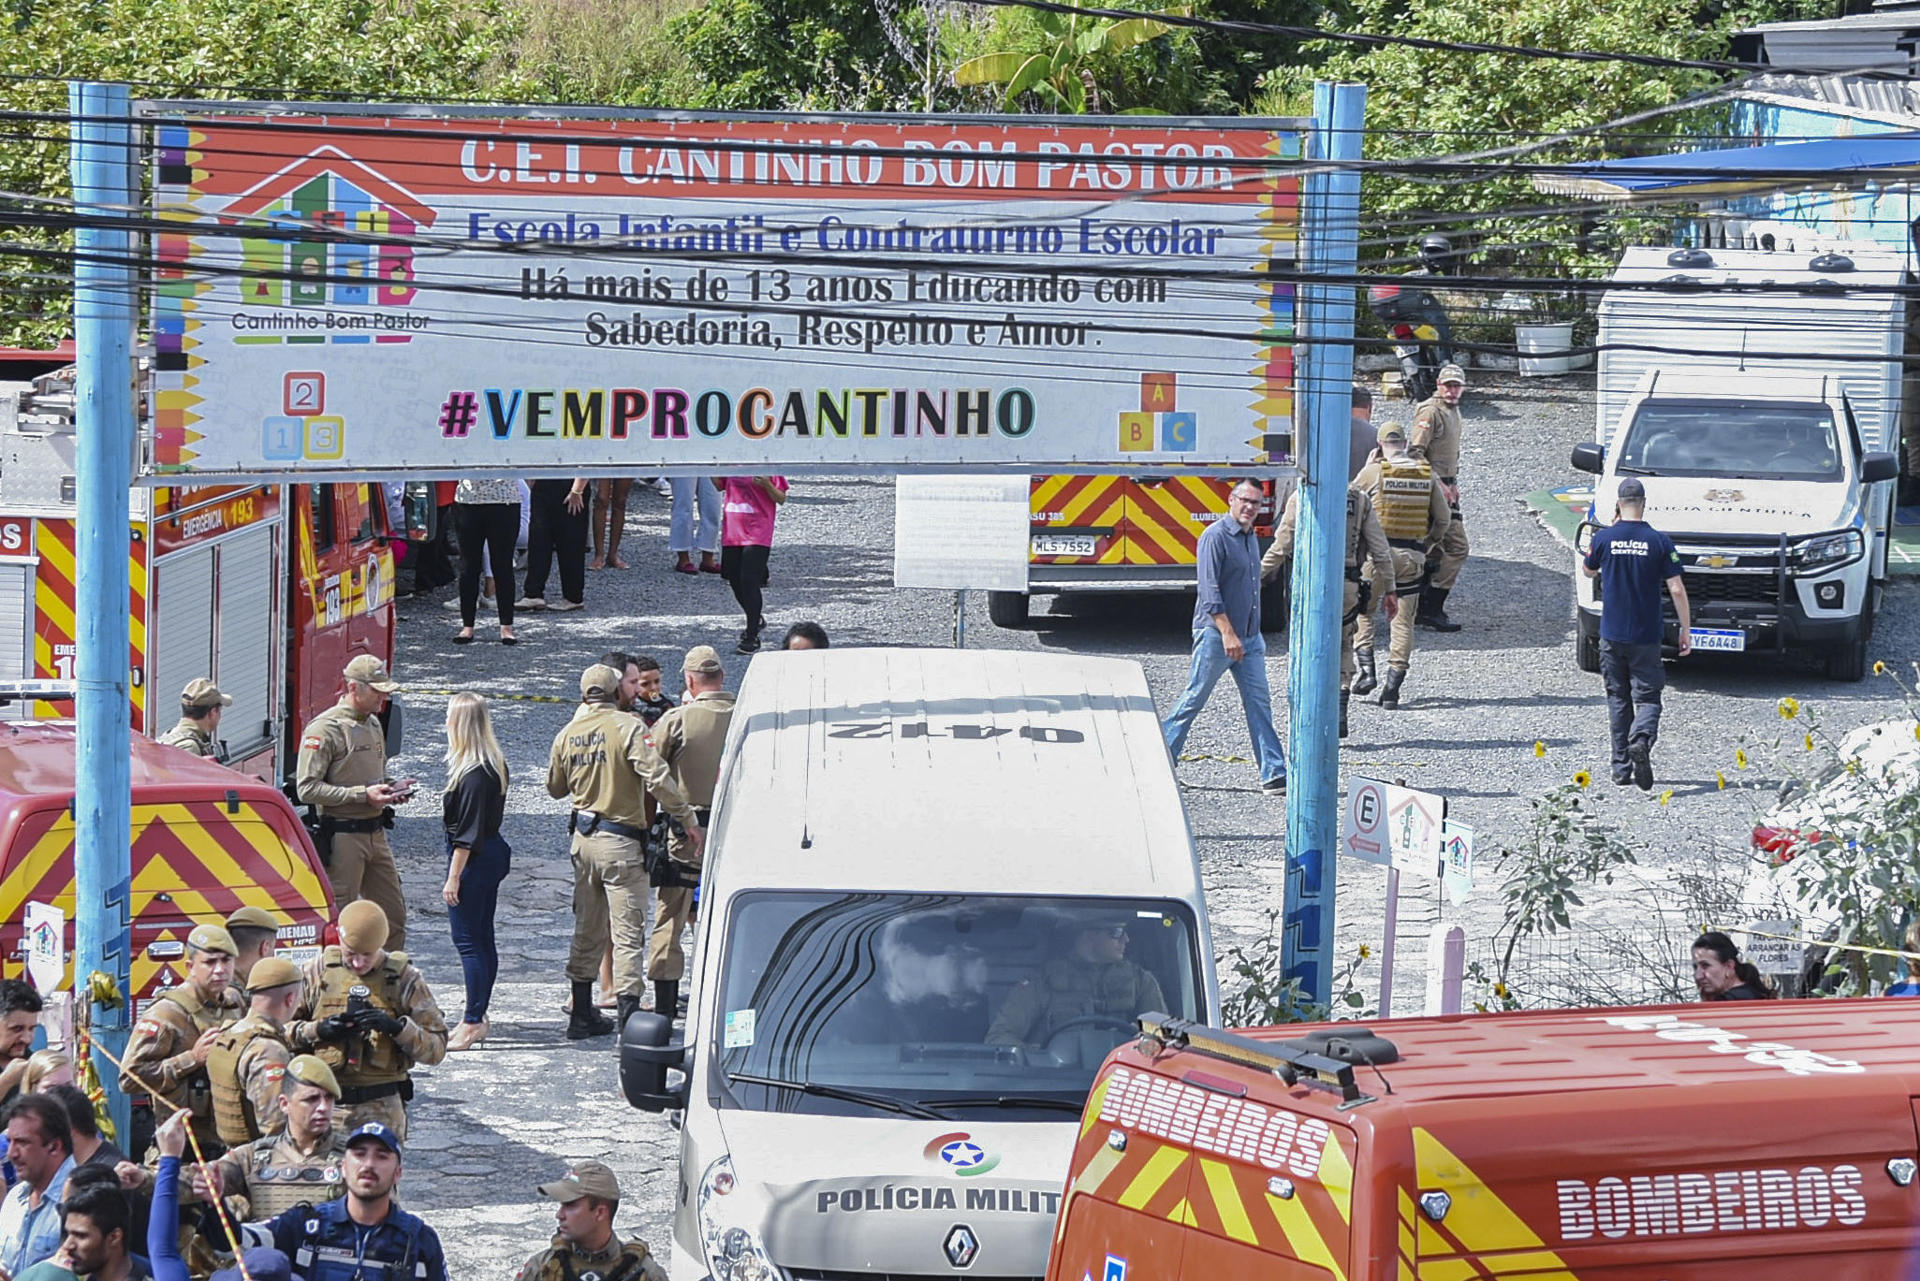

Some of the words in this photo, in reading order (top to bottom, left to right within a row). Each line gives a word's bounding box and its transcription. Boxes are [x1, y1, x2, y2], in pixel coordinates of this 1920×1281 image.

[460, 136, 597, 184] C.E.I.
[618, 137, 883, 187] CANTINHO
[903, 139, 1017, 189] BOM
[1038, 141, 1234, 192] PASTOR
[469, 212, 600, 250] Escola
[619, 214, 763, 252] Infantil
[780, 226, 801, 252] e
[817, 215, 1063, 254] Contraturno
[1079, 217, 1223, 256] Escolar
[521, 267, 569, 300] Há
[585, 268, 673, 301] mais
[686, 268, 729, 301] de
[745, 269, 791, 302] 13
[806, 276, 893, 302] anos
[907, 270, 1081, 304] Educando
[1094, 277, 1167, 304] com
[231, 312, 319, 330] Cantinho
[326, 312, 368, 330] Bom
[374, 312, 430, 330] Pastor
[585, 311, 782, 350] Sabedoria,
[799, 313, 953, 353] Respeito
[967, 320, 985, 346] e
[998, 313, 1102, 346] Amor.
[295, 382, 313, 406] 2
[1152, 382, 1165, 403] A
[440, 387, 1036, 439] #VEMPROCANTINHO
[276, 427, 288, 449] 1
[315, 426, 334, 449] 3
[1130, 422, 1143, 442] B
[1172, 421, 1186, 443] C
[230, 496, 254, 526] 193
[1360, 794, 1375, 824] E
[1100, 1067, 1330, 1178] BOMBEIROS
[817, 1184, 957, 1214] POLÍCIA
[1556, 1163, 1867, 1240] BOMBEIROS
